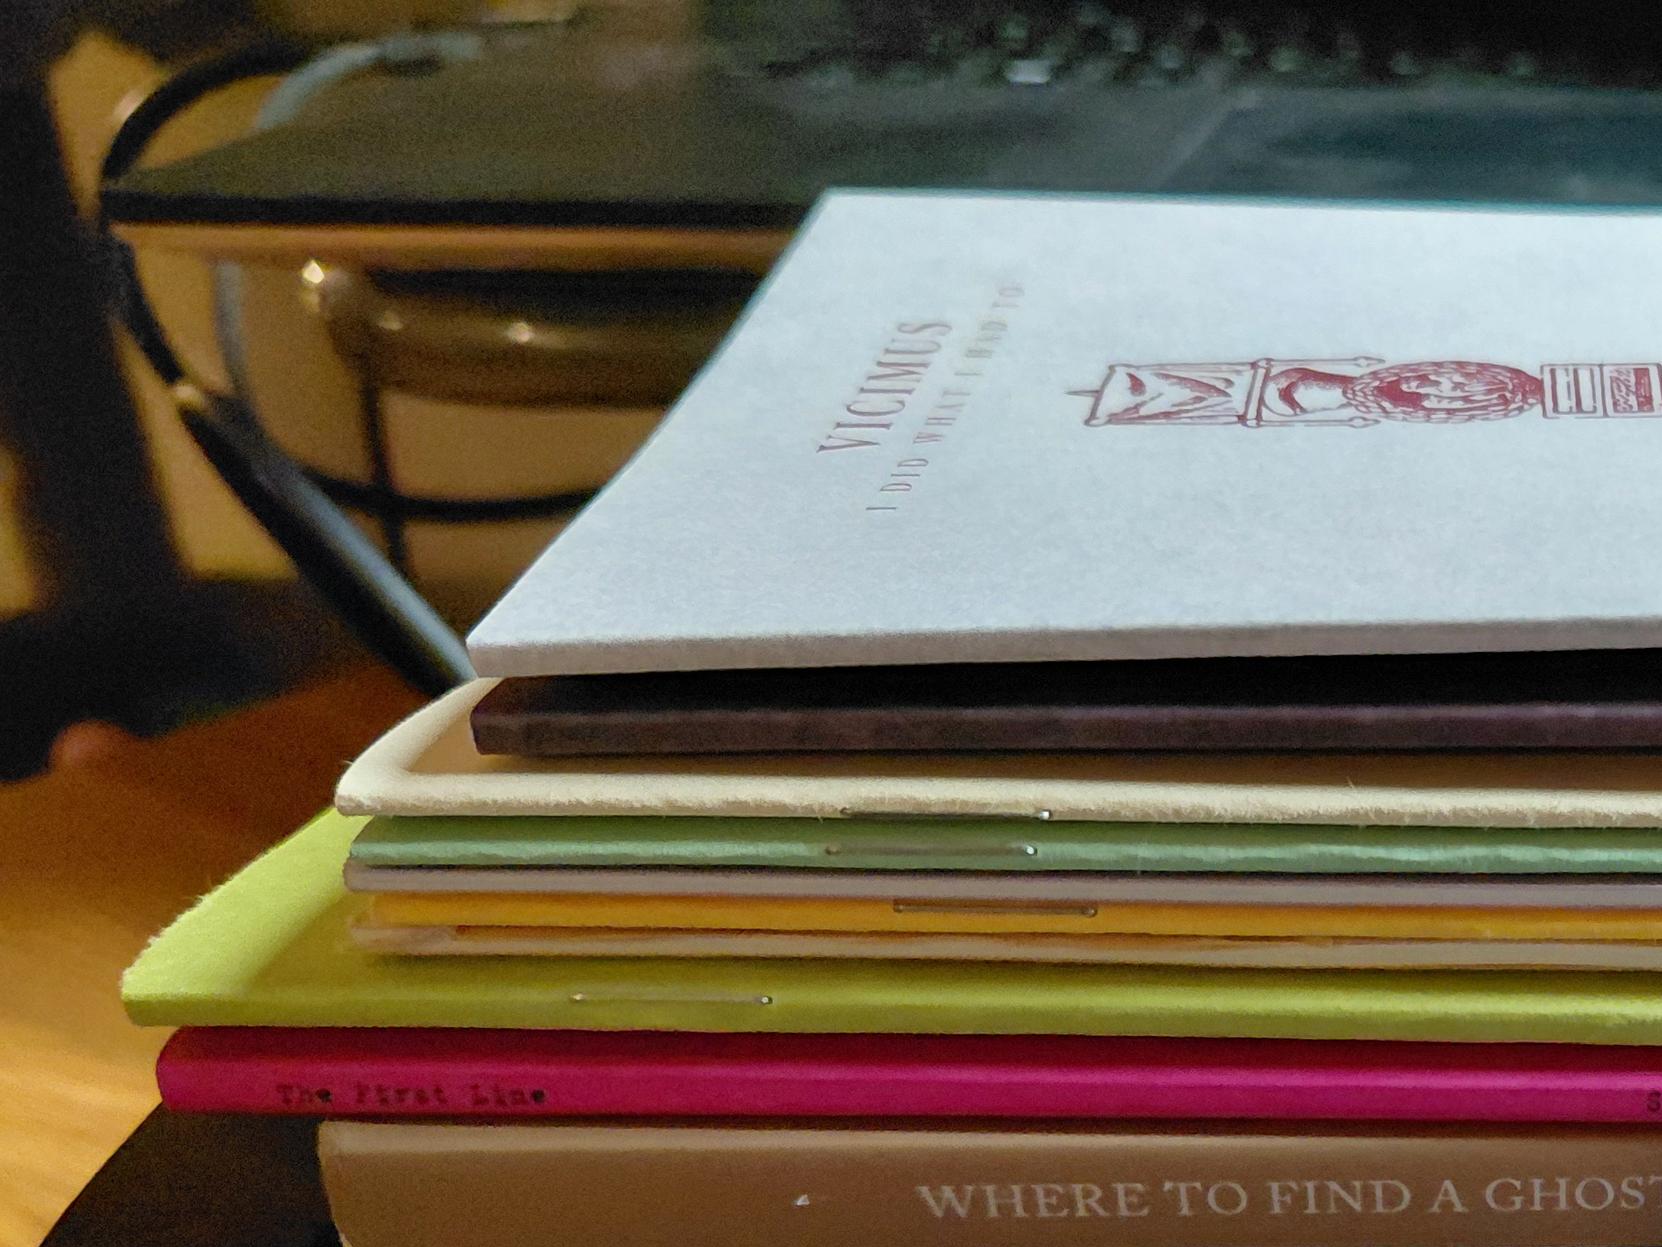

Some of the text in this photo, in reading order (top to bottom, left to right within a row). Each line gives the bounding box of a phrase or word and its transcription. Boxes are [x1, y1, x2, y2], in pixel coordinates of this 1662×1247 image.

[815, 322, 953, 454] VICIMUS
[879, 457, 929, 492] DID
[912, 387, 972, 444] WHAT
[914, 1181, 1152, 1219] WHERE
[1163, 1180, 1249, 1218] TO
[1266, 1178, 1412, 1215] FIND
[1427, 1178, 1470, 1214] A
